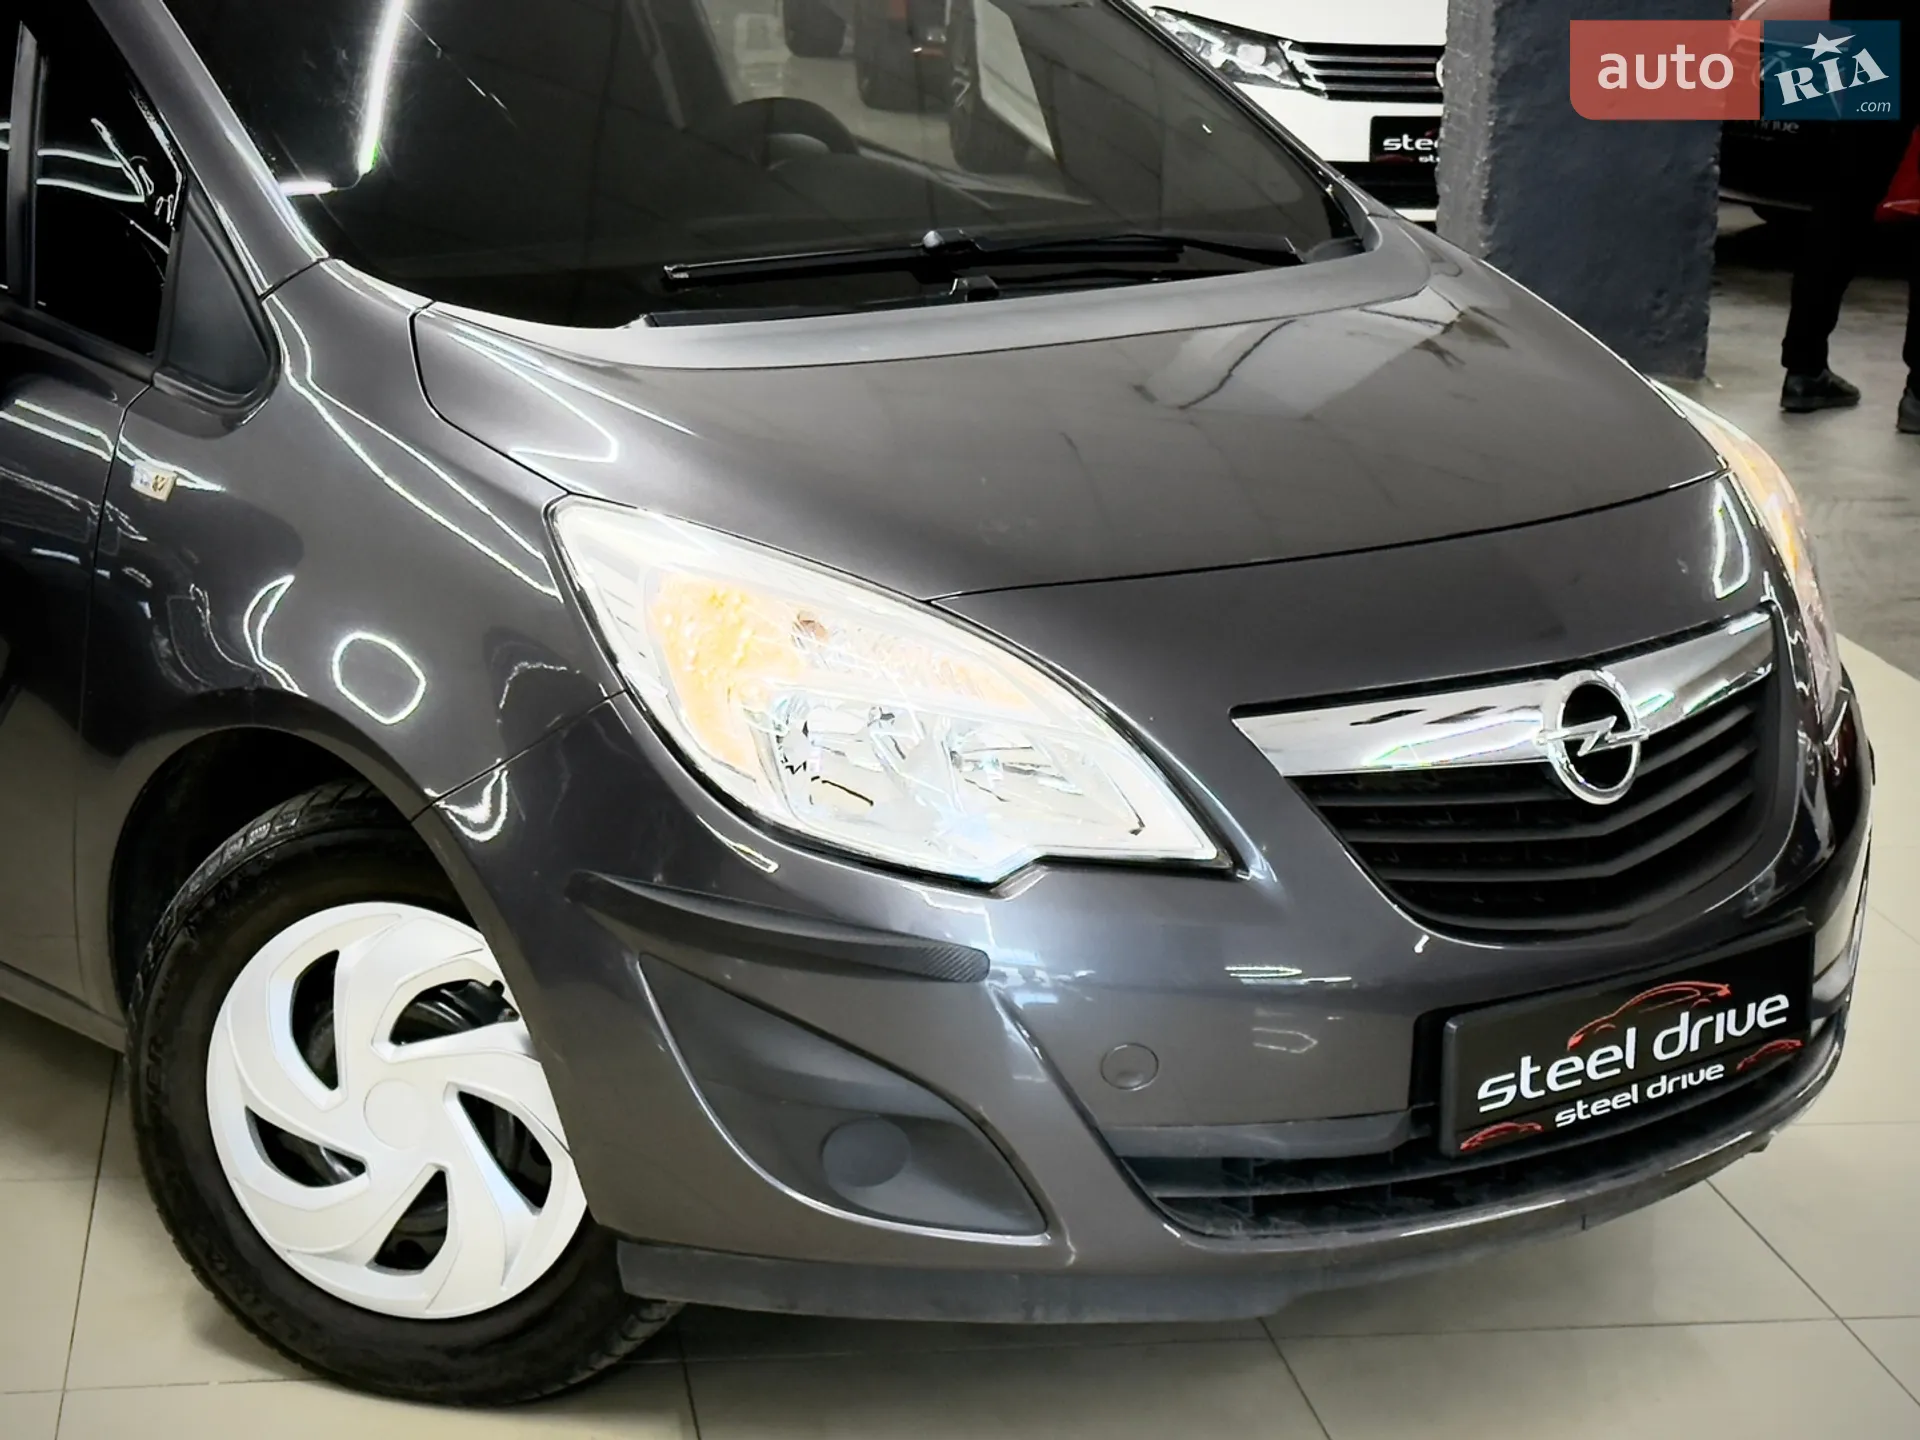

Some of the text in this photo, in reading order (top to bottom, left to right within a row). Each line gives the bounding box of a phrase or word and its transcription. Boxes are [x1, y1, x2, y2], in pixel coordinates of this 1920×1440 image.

[1383, 133, 1439, 151] ste
[1476, 993, 1791, 1114] steel drive
[1554, 1061, 1726, 1128] steel drive
